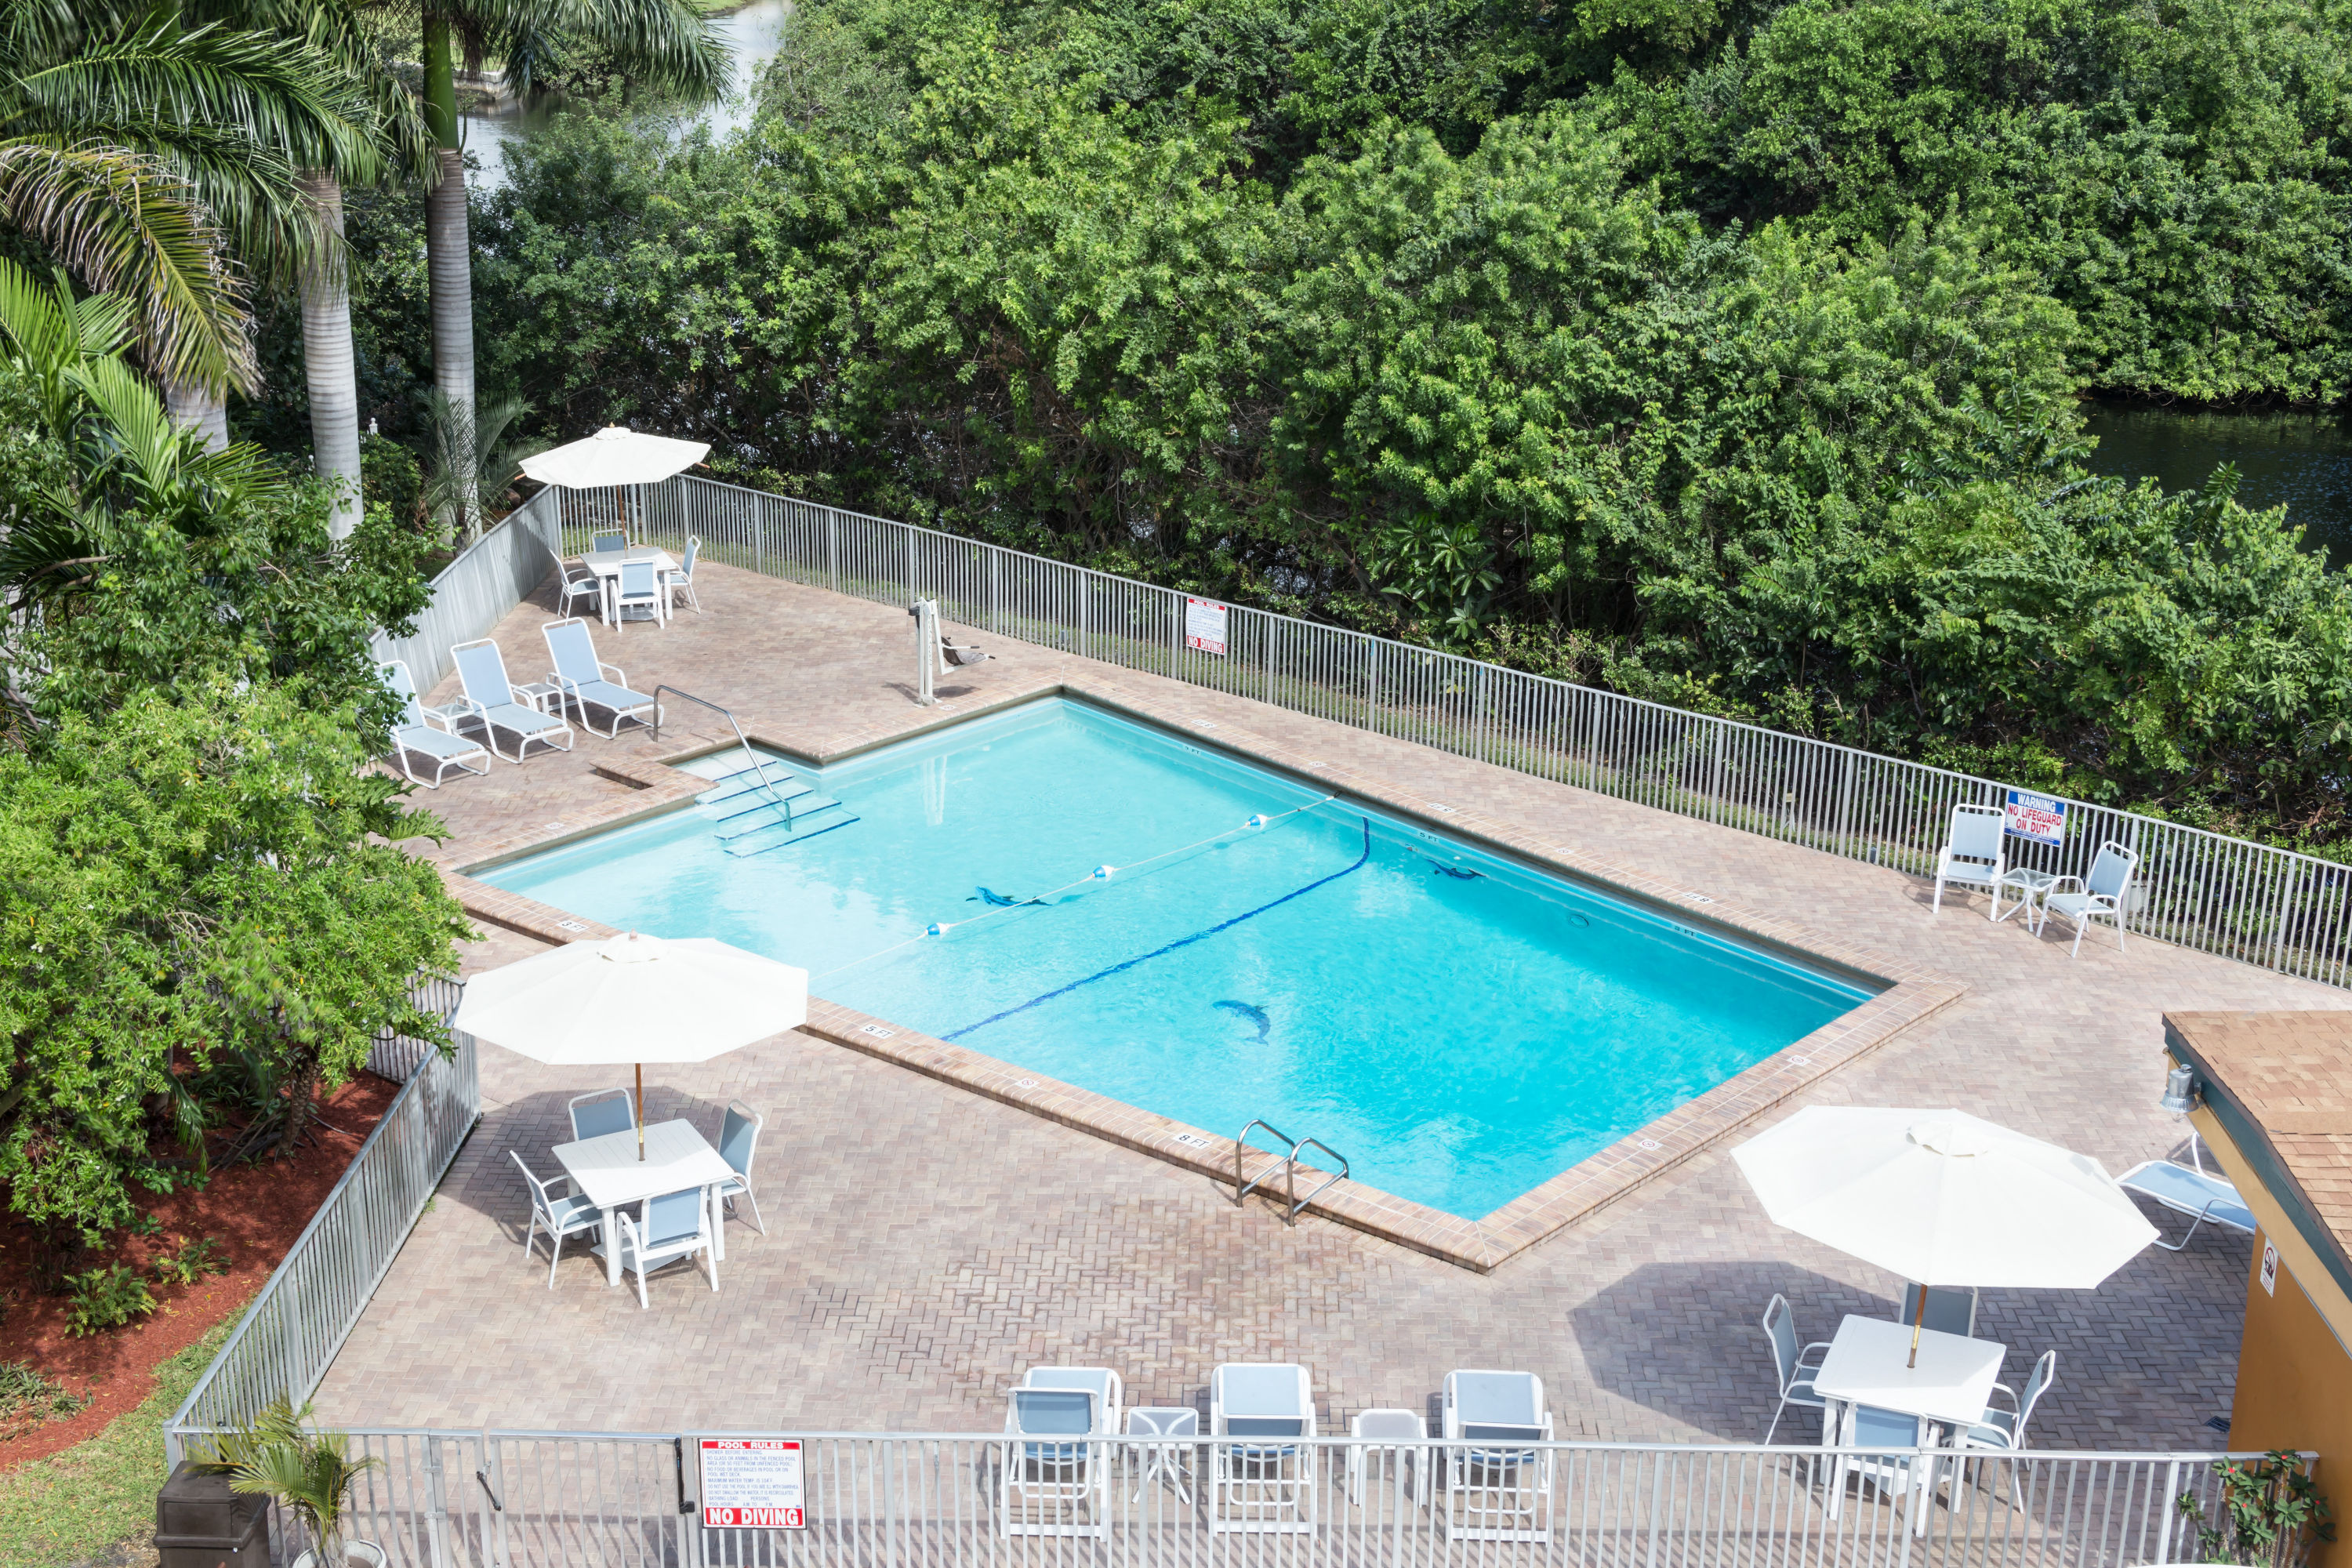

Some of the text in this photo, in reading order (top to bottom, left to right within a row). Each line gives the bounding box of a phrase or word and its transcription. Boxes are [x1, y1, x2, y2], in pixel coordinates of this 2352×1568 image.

[1189, 637, 1222, 653] NO DIVING
[2017, 793, 2056, 813] WARNING
[2008, 804, 2062, 826] NO LIFEGUARD
[2016, 818, 2027, 831] ON
[2031, 822, 2051, 836] DUTY
[1190, 1138, 1210, 1147] FT
[710, 1508, 799, 1525] NO DIVING
